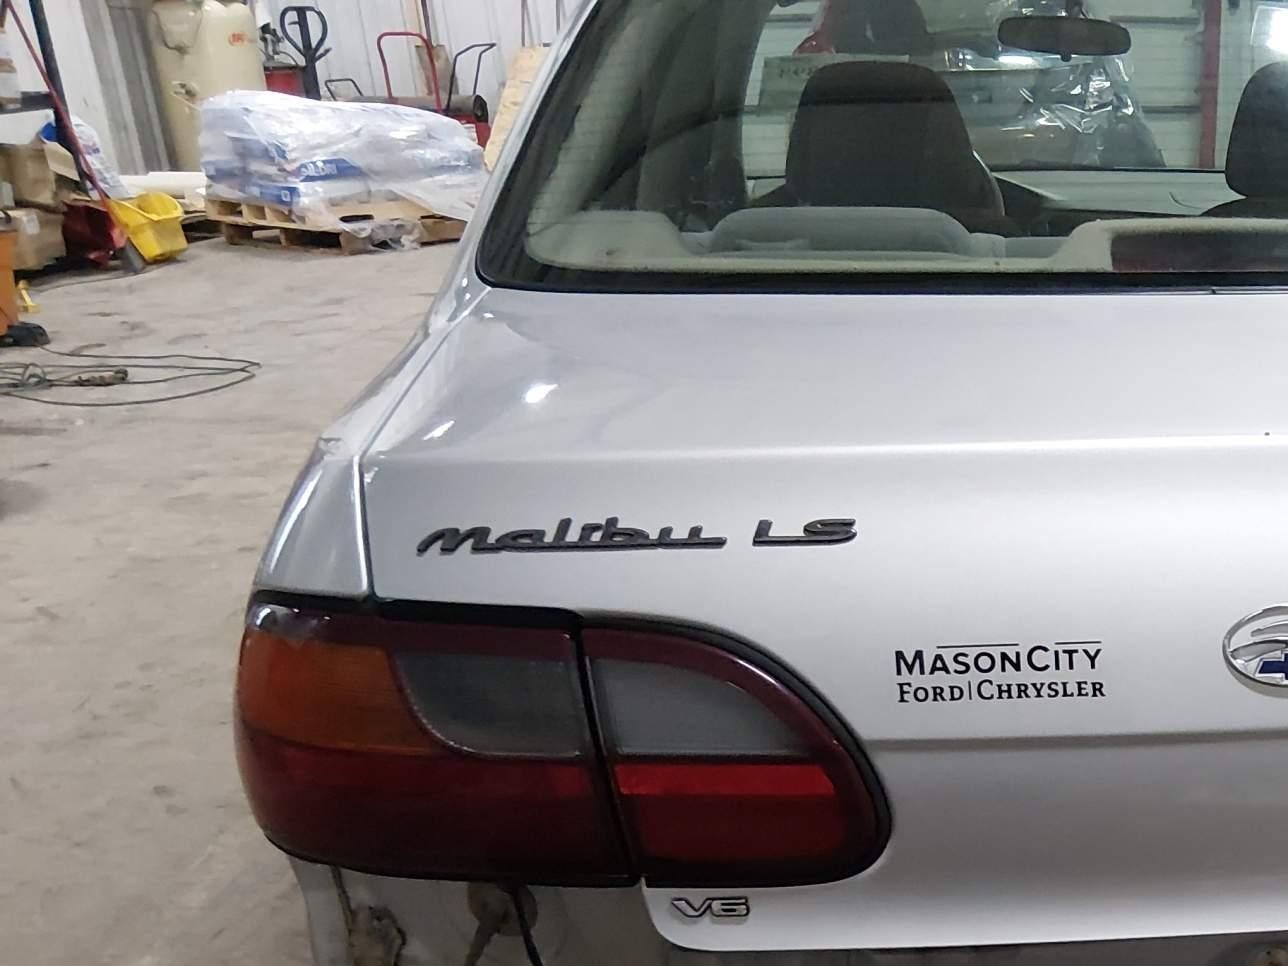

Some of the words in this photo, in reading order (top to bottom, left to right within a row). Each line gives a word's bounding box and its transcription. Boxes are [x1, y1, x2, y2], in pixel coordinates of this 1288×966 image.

[417, 517, 727, 554] Malibu
[752, 518, 857, 547] LS
[671, 896, 751, 918] V6
